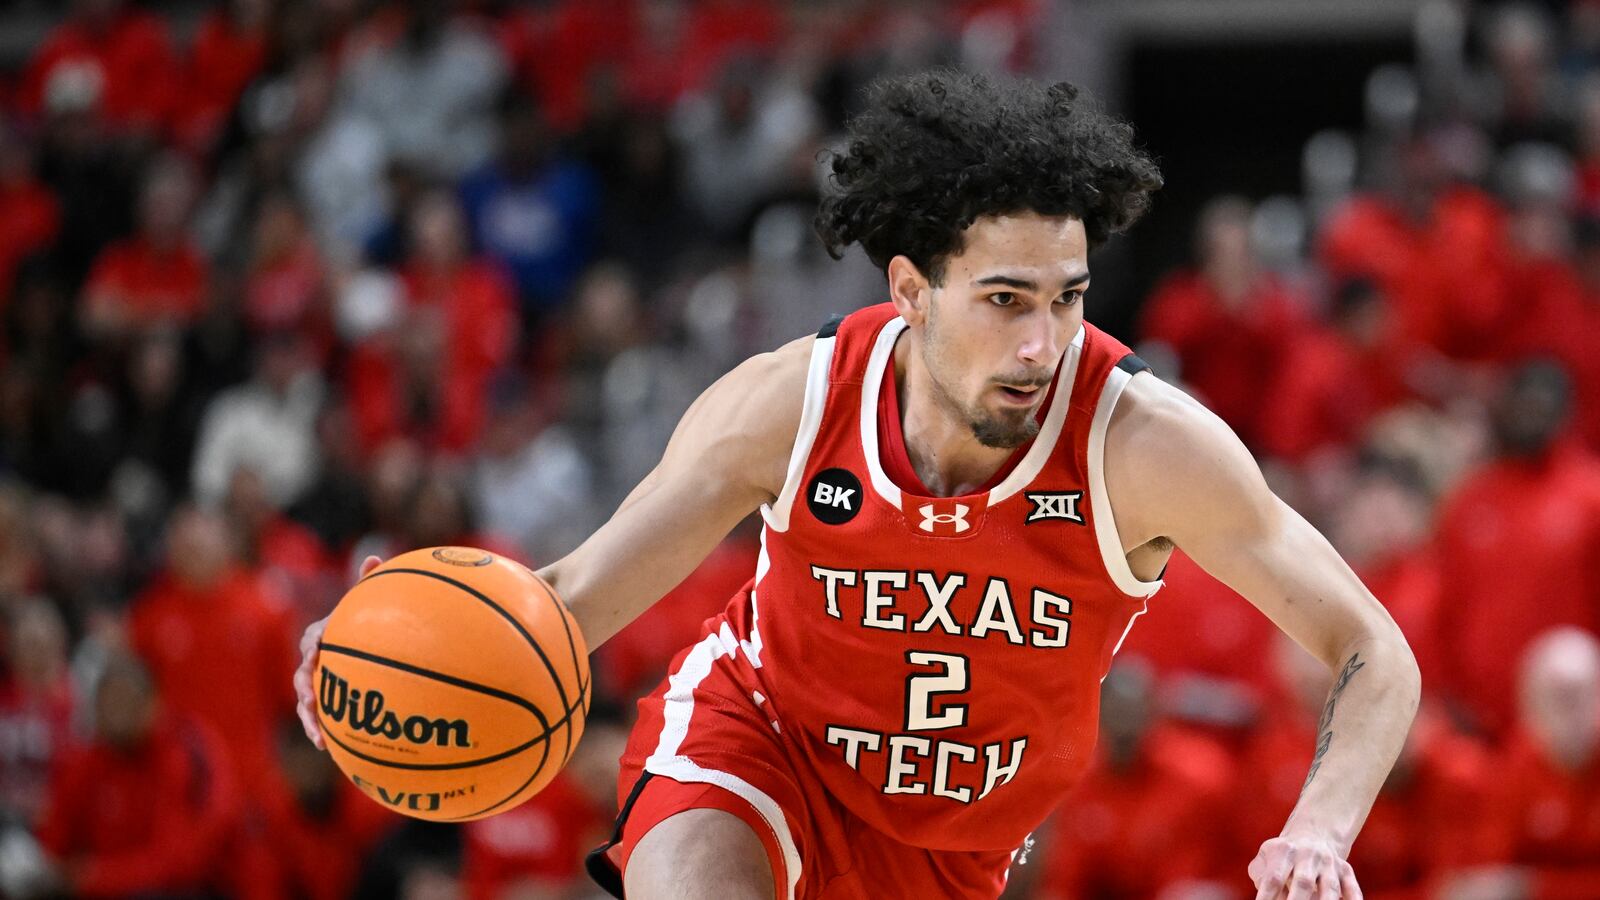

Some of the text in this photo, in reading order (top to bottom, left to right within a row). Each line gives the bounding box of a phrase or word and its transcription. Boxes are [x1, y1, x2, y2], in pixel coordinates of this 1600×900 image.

[812, 481, 857, 511] BK
[1026, 492, 1084, 523] XII
[811, 564, 1072, 648] TEXAS
[319, 665, 471, 747] Wilson
[906, 650, 968, 731] 2
[826, 726, 1028, 804] TECH
